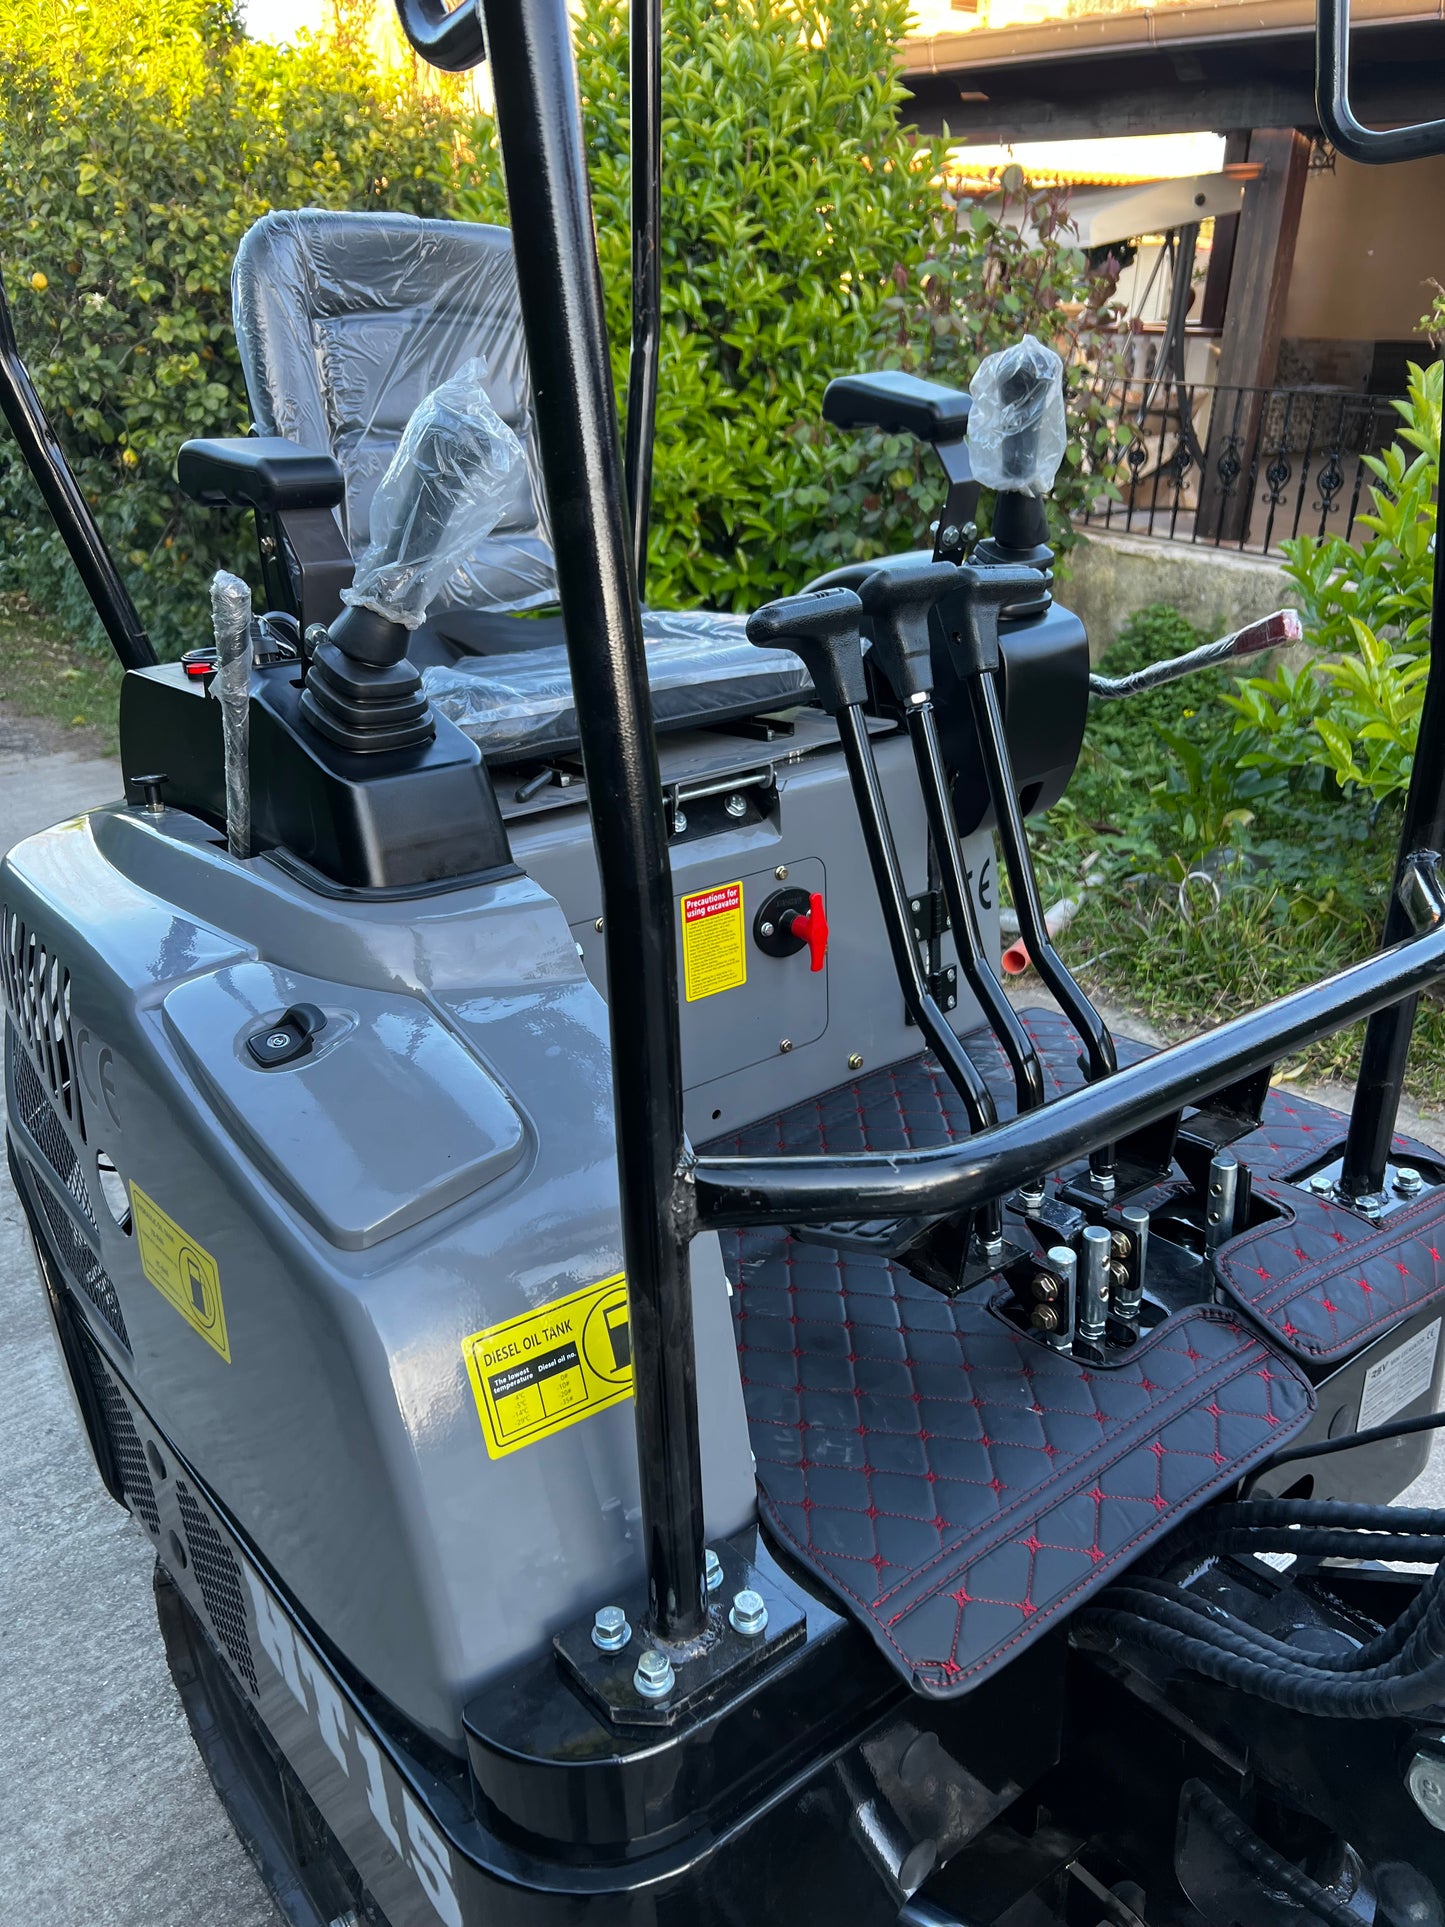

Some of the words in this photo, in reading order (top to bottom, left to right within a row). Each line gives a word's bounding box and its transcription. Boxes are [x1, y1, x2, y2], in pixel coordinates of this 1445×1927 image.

[967, 856, 991, 910] E
[686, 892, 725, 909] Precautions
[727, 889, 737, 898] for
[687, 907, 706, 917] using
[707, 897, 739, 912] excavator
[483, 1342, 521, 1367] DIESEL
[522, 1333, 541, 1350] OIL
[542, 1319, 573, 1341] TANK
[537, 1359, 557, 1373] Diesel
[557, 1354, 566, 1364] oil
[566, 1351, 577, 1360] no.
[493, 1373, 534, 1394] temperature
[494, 1377, 507, 1387] The
[508, 1367, 530, 1381] lowest
[242, 1556, 464, 1927] HT15
